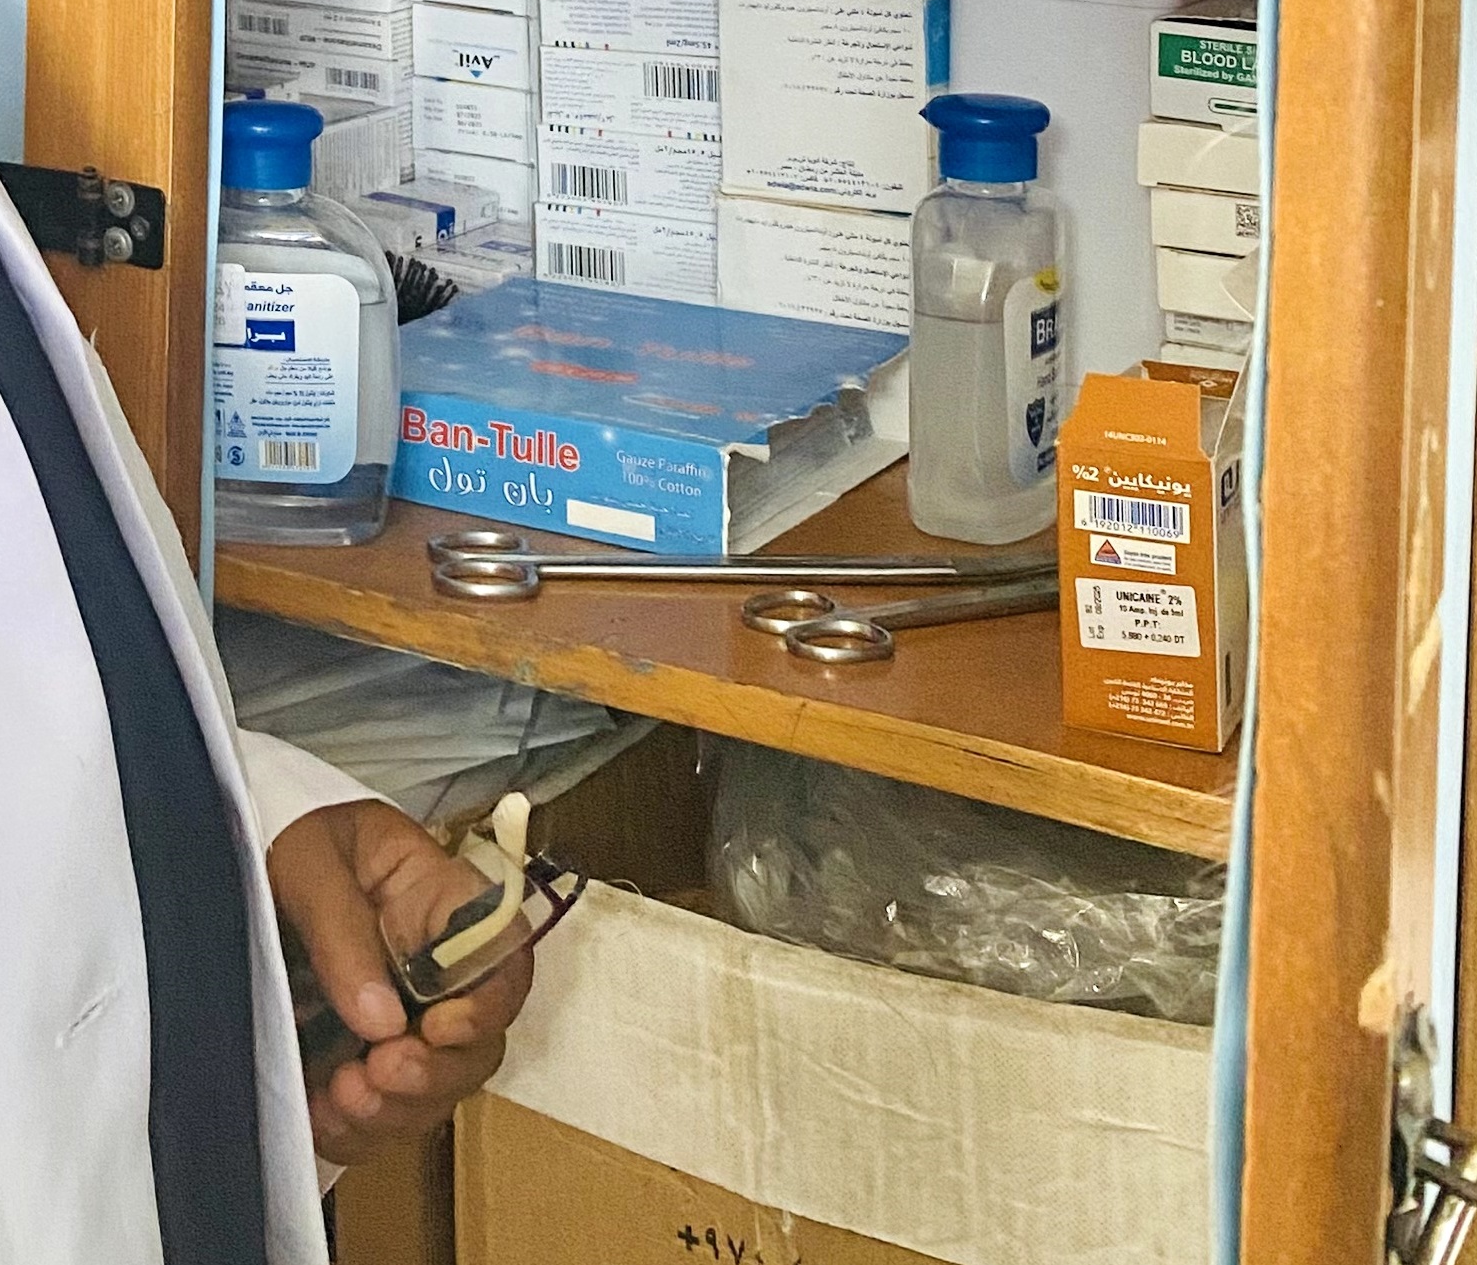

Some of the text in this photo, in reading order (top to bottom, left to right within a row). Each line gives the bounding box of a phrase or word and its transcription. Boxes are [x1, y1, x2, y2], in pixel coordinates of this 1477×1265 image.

[1199, 40, 1244, 54] STERILE
[458, 52, 494, 70] Avil
[1180, 49, 1238, 69] BLOOD
[1174, 65, 1220, 79] Sterilized
[1221, 72, 1235, 82] by
[275, 284, 294, 295] جل
[245, 301, 295, 312] anitizer
[401, 406, 581, 473] Ban-Tulle
[616, 449, 656, 469] Gauze
[428, 456, 487, 496] تول
[502, 472, 554, 514] بان
[658, 478, 702, 497] Cotton
[1116, 590, 1183, 606] UNICAINE 2%
[1174, 635, 1185, 644] DT
